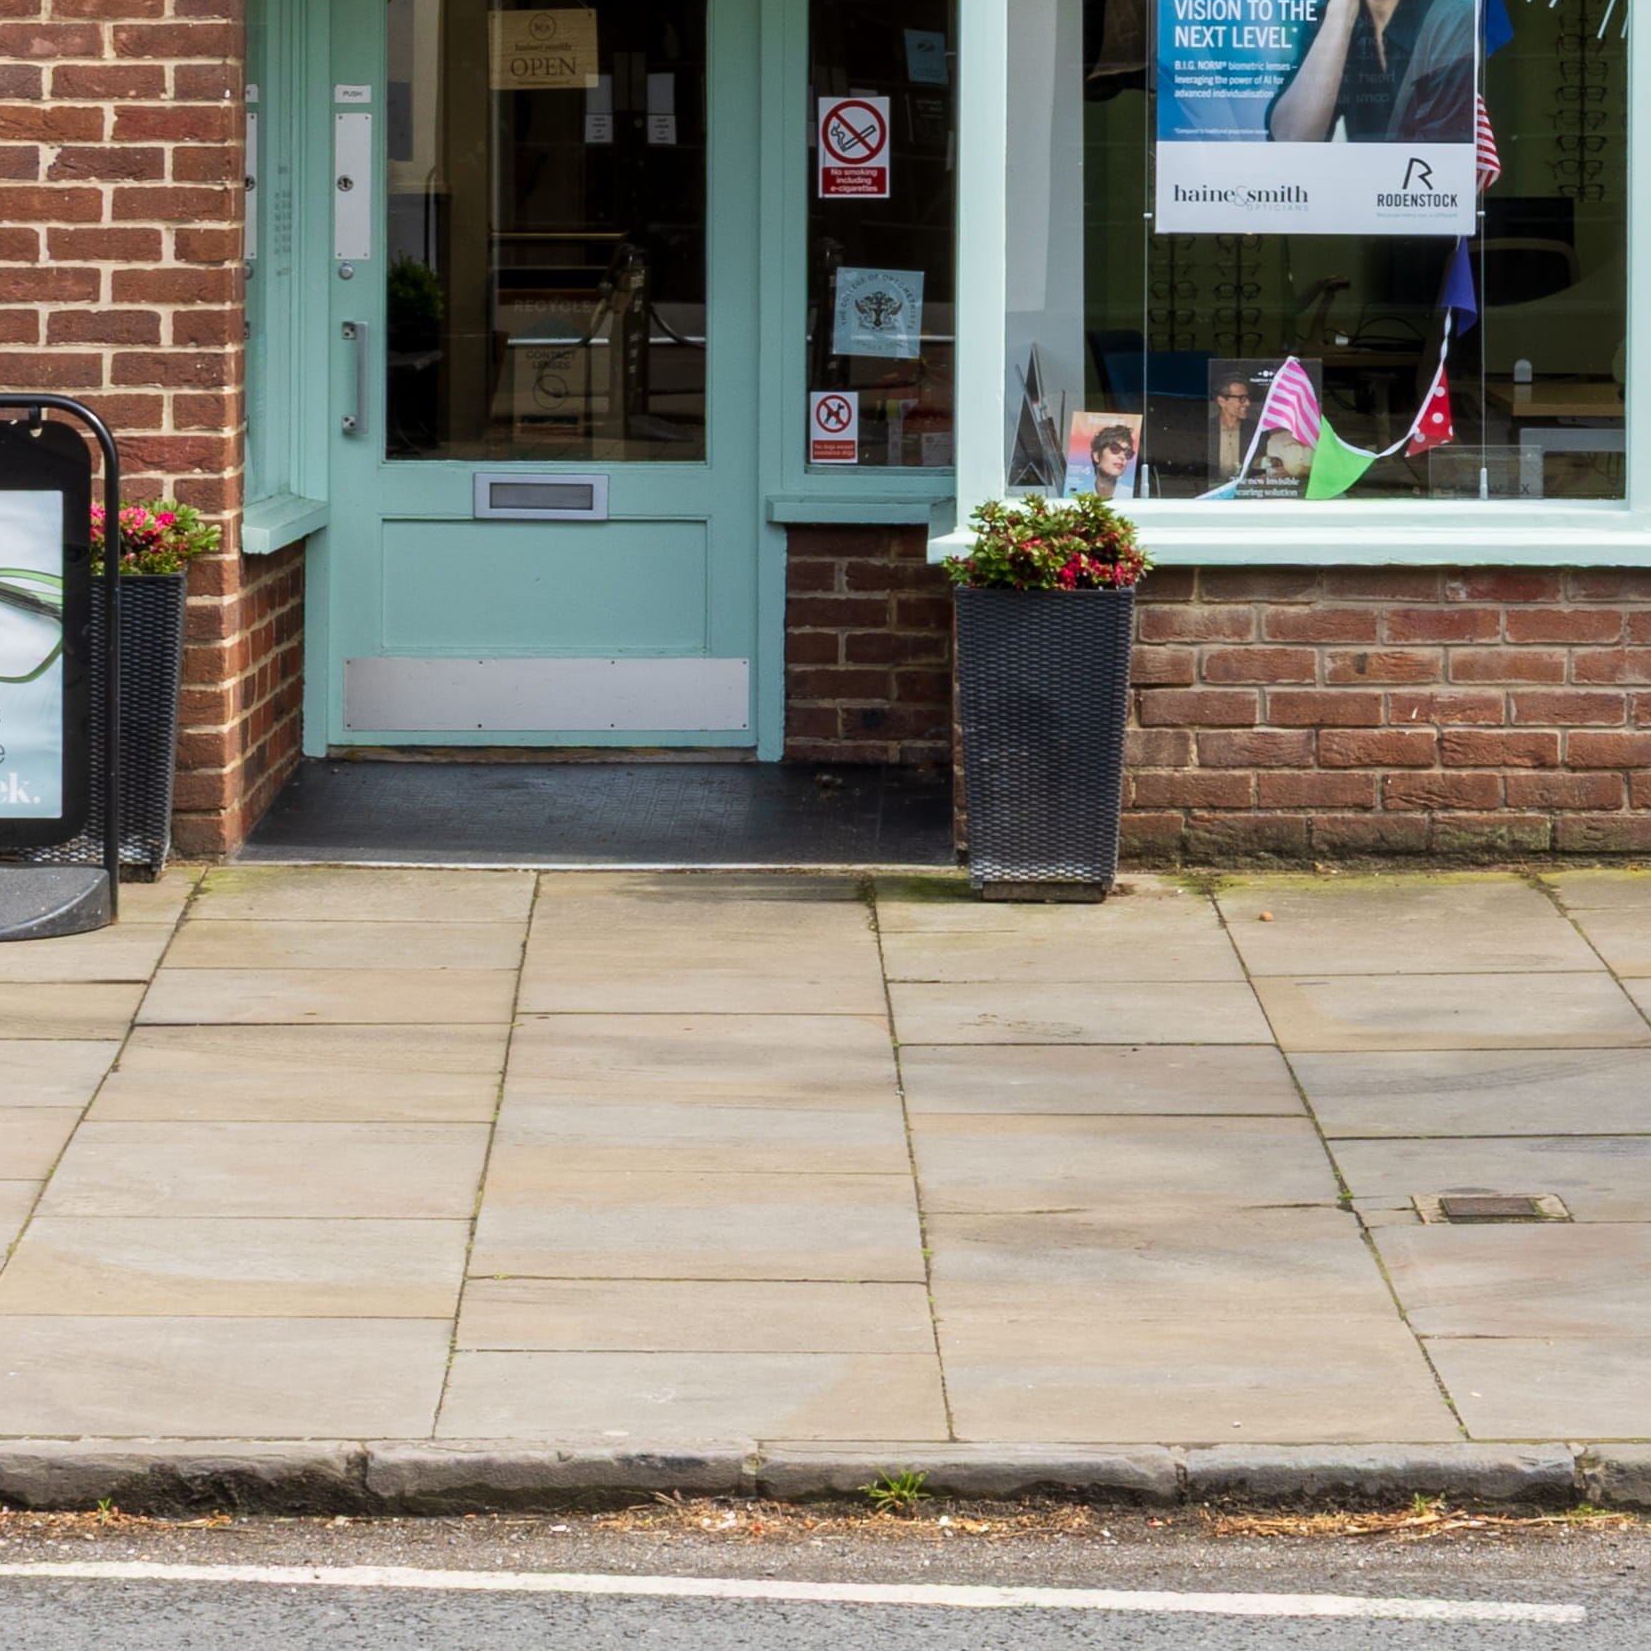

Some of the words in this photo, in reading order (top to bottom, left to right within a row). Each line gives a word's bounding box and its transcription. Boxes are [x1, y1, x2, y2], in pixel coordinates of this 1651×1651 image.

[1174, 0, 1242, 21] VISION
[1246, 0, 1273, 21] TO
[1277, 0, 1318, 21] THE
[1174, 26, 1227, 48] NEXT
[510, 56, 577, 77] OPEN
[1174, 60, 1196, 70] B.I.G.
[1228, 61, 1264, 70] biometric
[1265, 61, 1291, 70] lenses
[1174, 75, 1214, 86] leveraging
[1215, 75, 1228, 85] the
[1229, 77, 1253, 86] power
[1254, 75, 1263, 85] of
[1263, 75, 1273, 85] AI
[1273, 75, 1284, 85] for
[1174, 88, 1212, 98] advanced
[1213, 88, 1274, 98] individualisation
[831, 168, 842, 176] No
[844, 167, 878, 177] smoking
[836, 176, 873, 186] including
[830, 184, 878, 193] e-cigarettes
[1173, 184, 1309, 207] haine&smith
[1376, 193, 1458, 208] RODENSTOCK
[1246, 204, 1309, 212] OPTICIANS
[514, 299, 592, 313] RECYCLE
[526, 350, 577, 359] CONTACT
[532, 361, 572, 369] LENSES
[1266, 477, 1300, 485] invisible
[1234, 489, 1264, 497] earing
